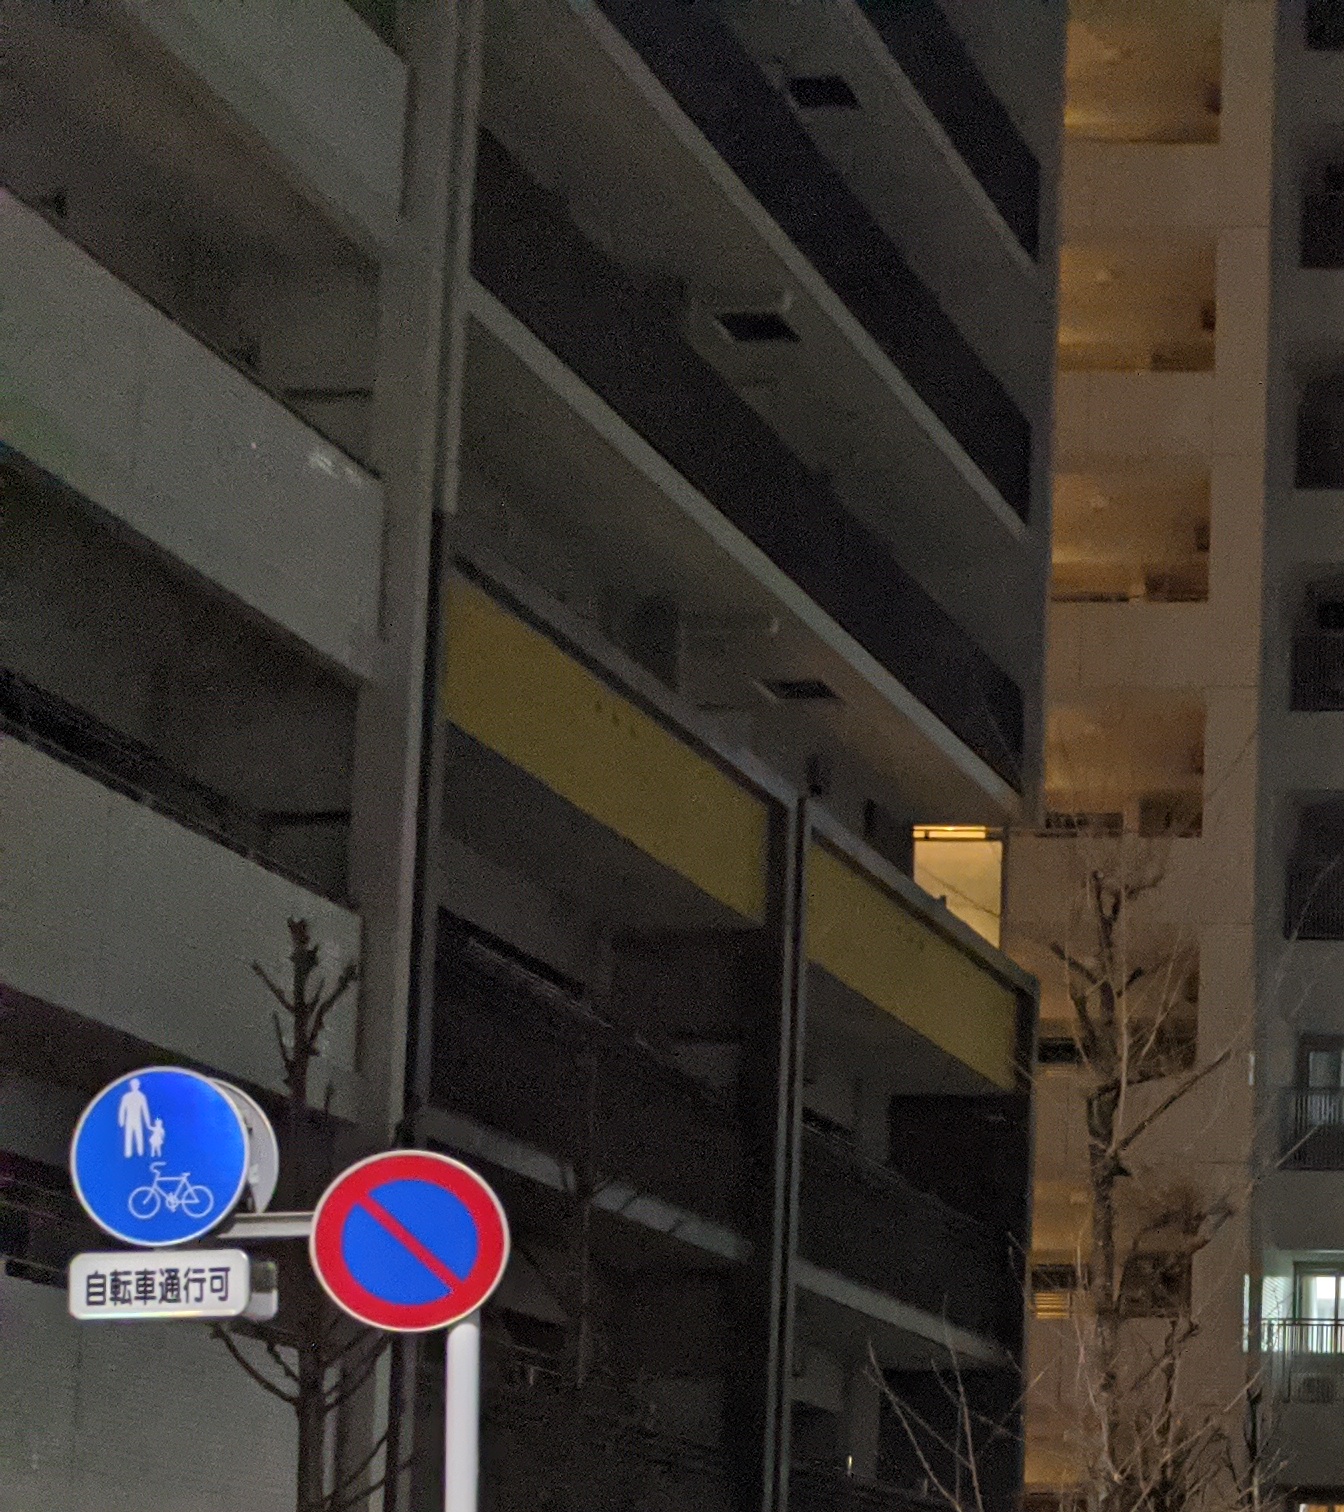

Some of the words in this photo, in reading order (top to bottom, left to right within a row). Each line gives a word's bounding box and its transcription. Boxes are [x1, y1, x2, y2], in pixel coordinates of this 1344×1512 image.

[86, 1267, 231, 1306] 自転車通行可
